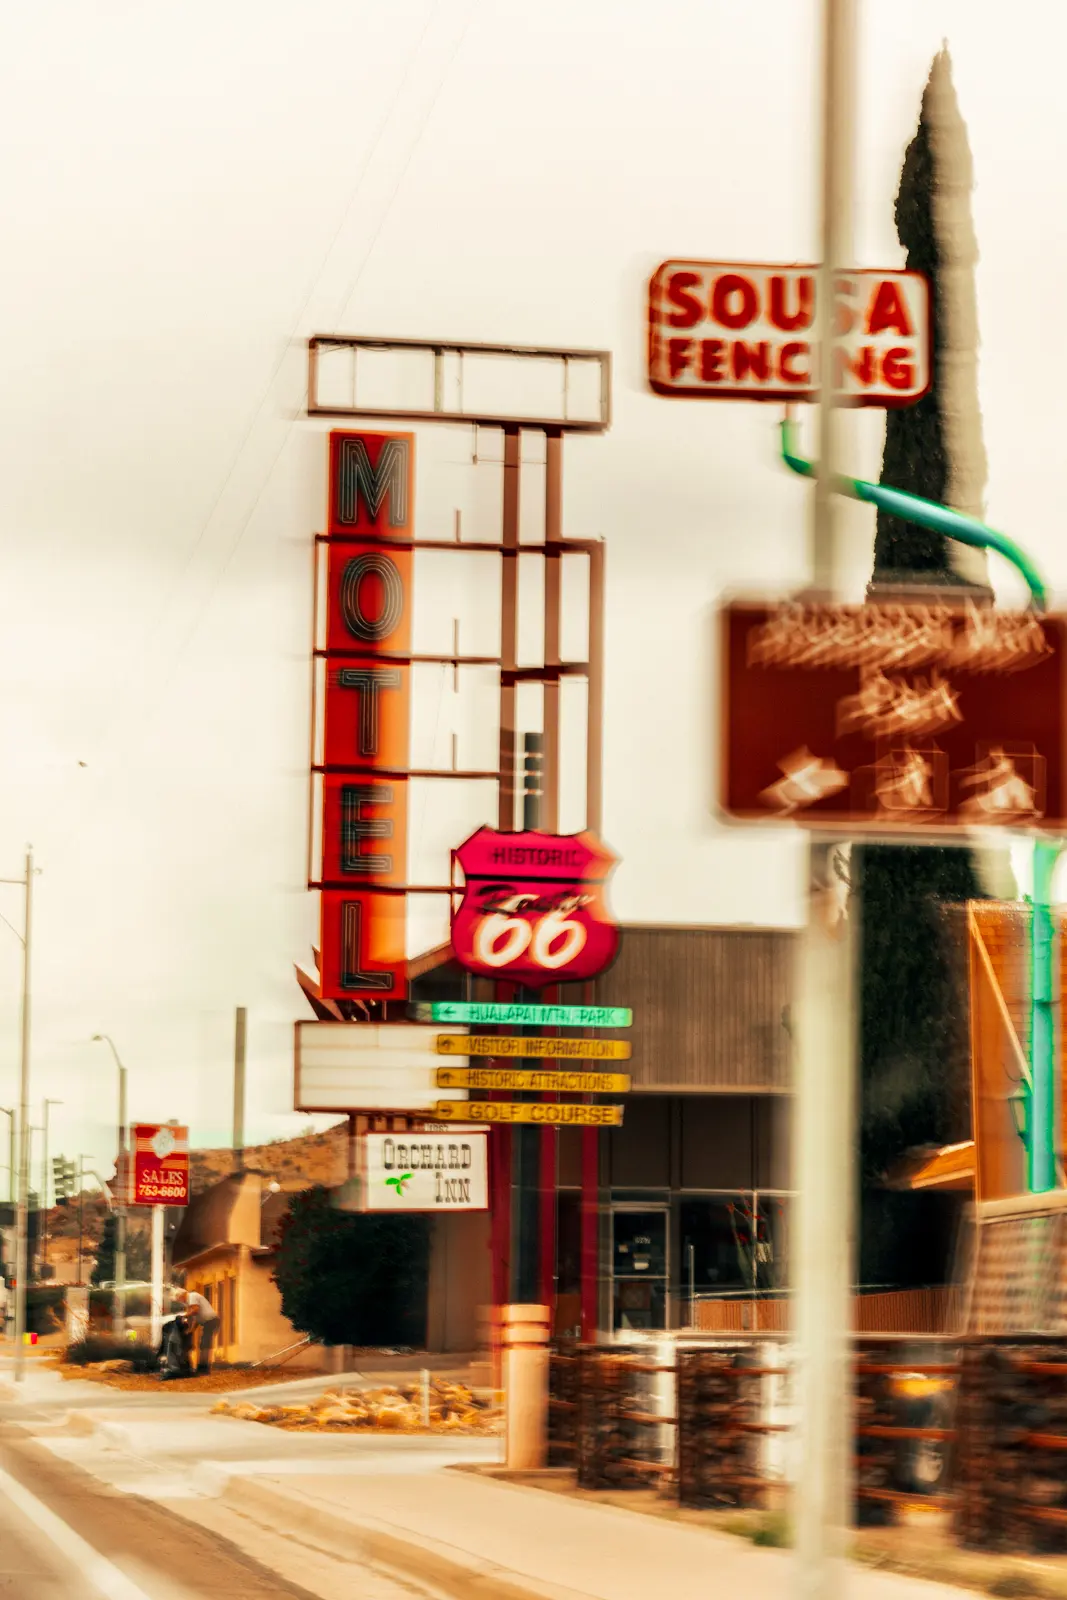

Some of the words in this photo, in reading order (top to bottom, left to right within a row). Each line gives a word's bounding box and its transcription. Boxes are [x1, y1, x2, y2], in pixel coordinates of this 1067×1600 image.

[667, 337, 915, 390] FENCNG
[338, 438, 408, 991] MOTEL
[493, 847, 584, 867] HISTORIC
[476, 902, 587, 969] 66
[579, 1008, 617, 1024] PARK
[468, 1037, 519, 1054] VISITOR
[526, 1040, 615, 1057] INFORMATION
[467, 1071, 524, 1088] HISTORIC
[529, 1073, 614, 1091] ATTRACTIONS
[467, 1104, 521, 1121] GOLF
[530, 1106, 614, 1124] COURSE
[142, 1168, 184, 1186] SALES
[139, 1184, 187, 1198] 753-6600
